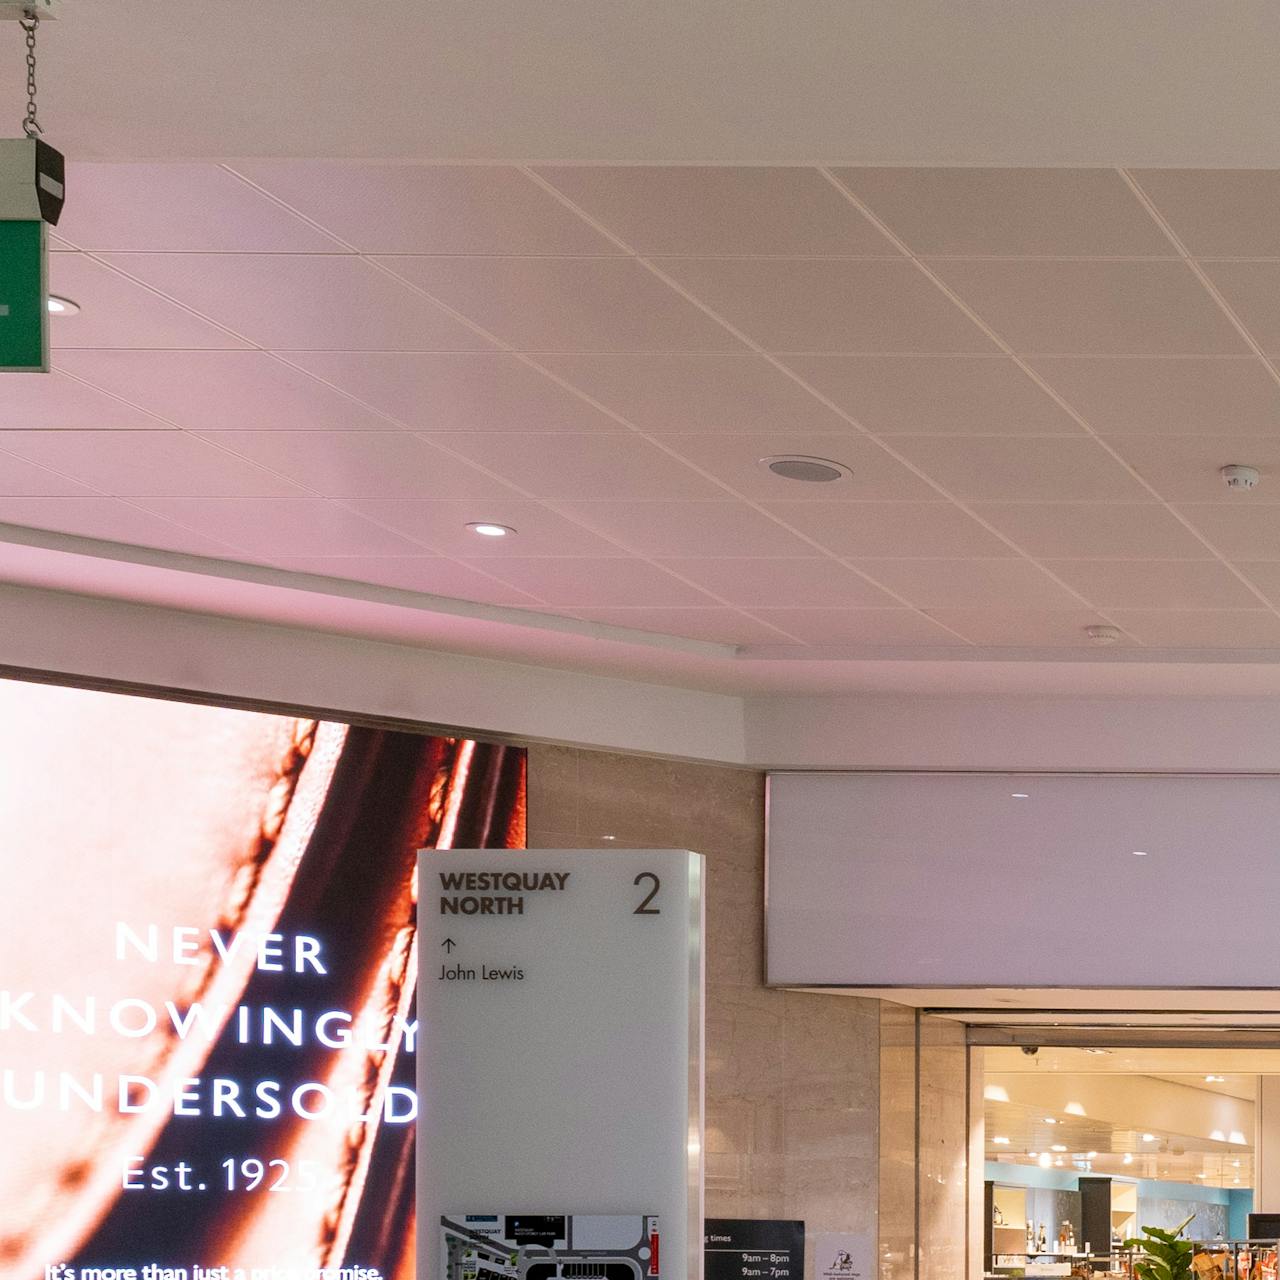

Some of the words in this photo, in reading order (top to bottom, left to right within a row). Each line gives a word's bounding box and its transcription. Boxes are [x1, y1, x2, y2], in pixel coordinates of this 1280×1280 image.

[439, 872, 570, 891] WESTQUAY
[632, 872, 661, 915] 2
[440, 897, 524, 915] NORTH
[116, 921, 327, 974] NEVER
[439, 964, 475, 981] John
[482, 964, 524, 981] Lewis
[4, 1069, 418, 1124] UNDERSOLD
[122, 1156, 206, 1191] Est.
[222, 1158, 317, 1193] 1925
[710, 1234, 732, 1242] times
[742, 1253, 761, 1262] 9am
[770, 1254, 789, 1264] 8pm
[742, 1267, 761, 1276] 9am
[770, 1267, 789, 1278] 7pm
